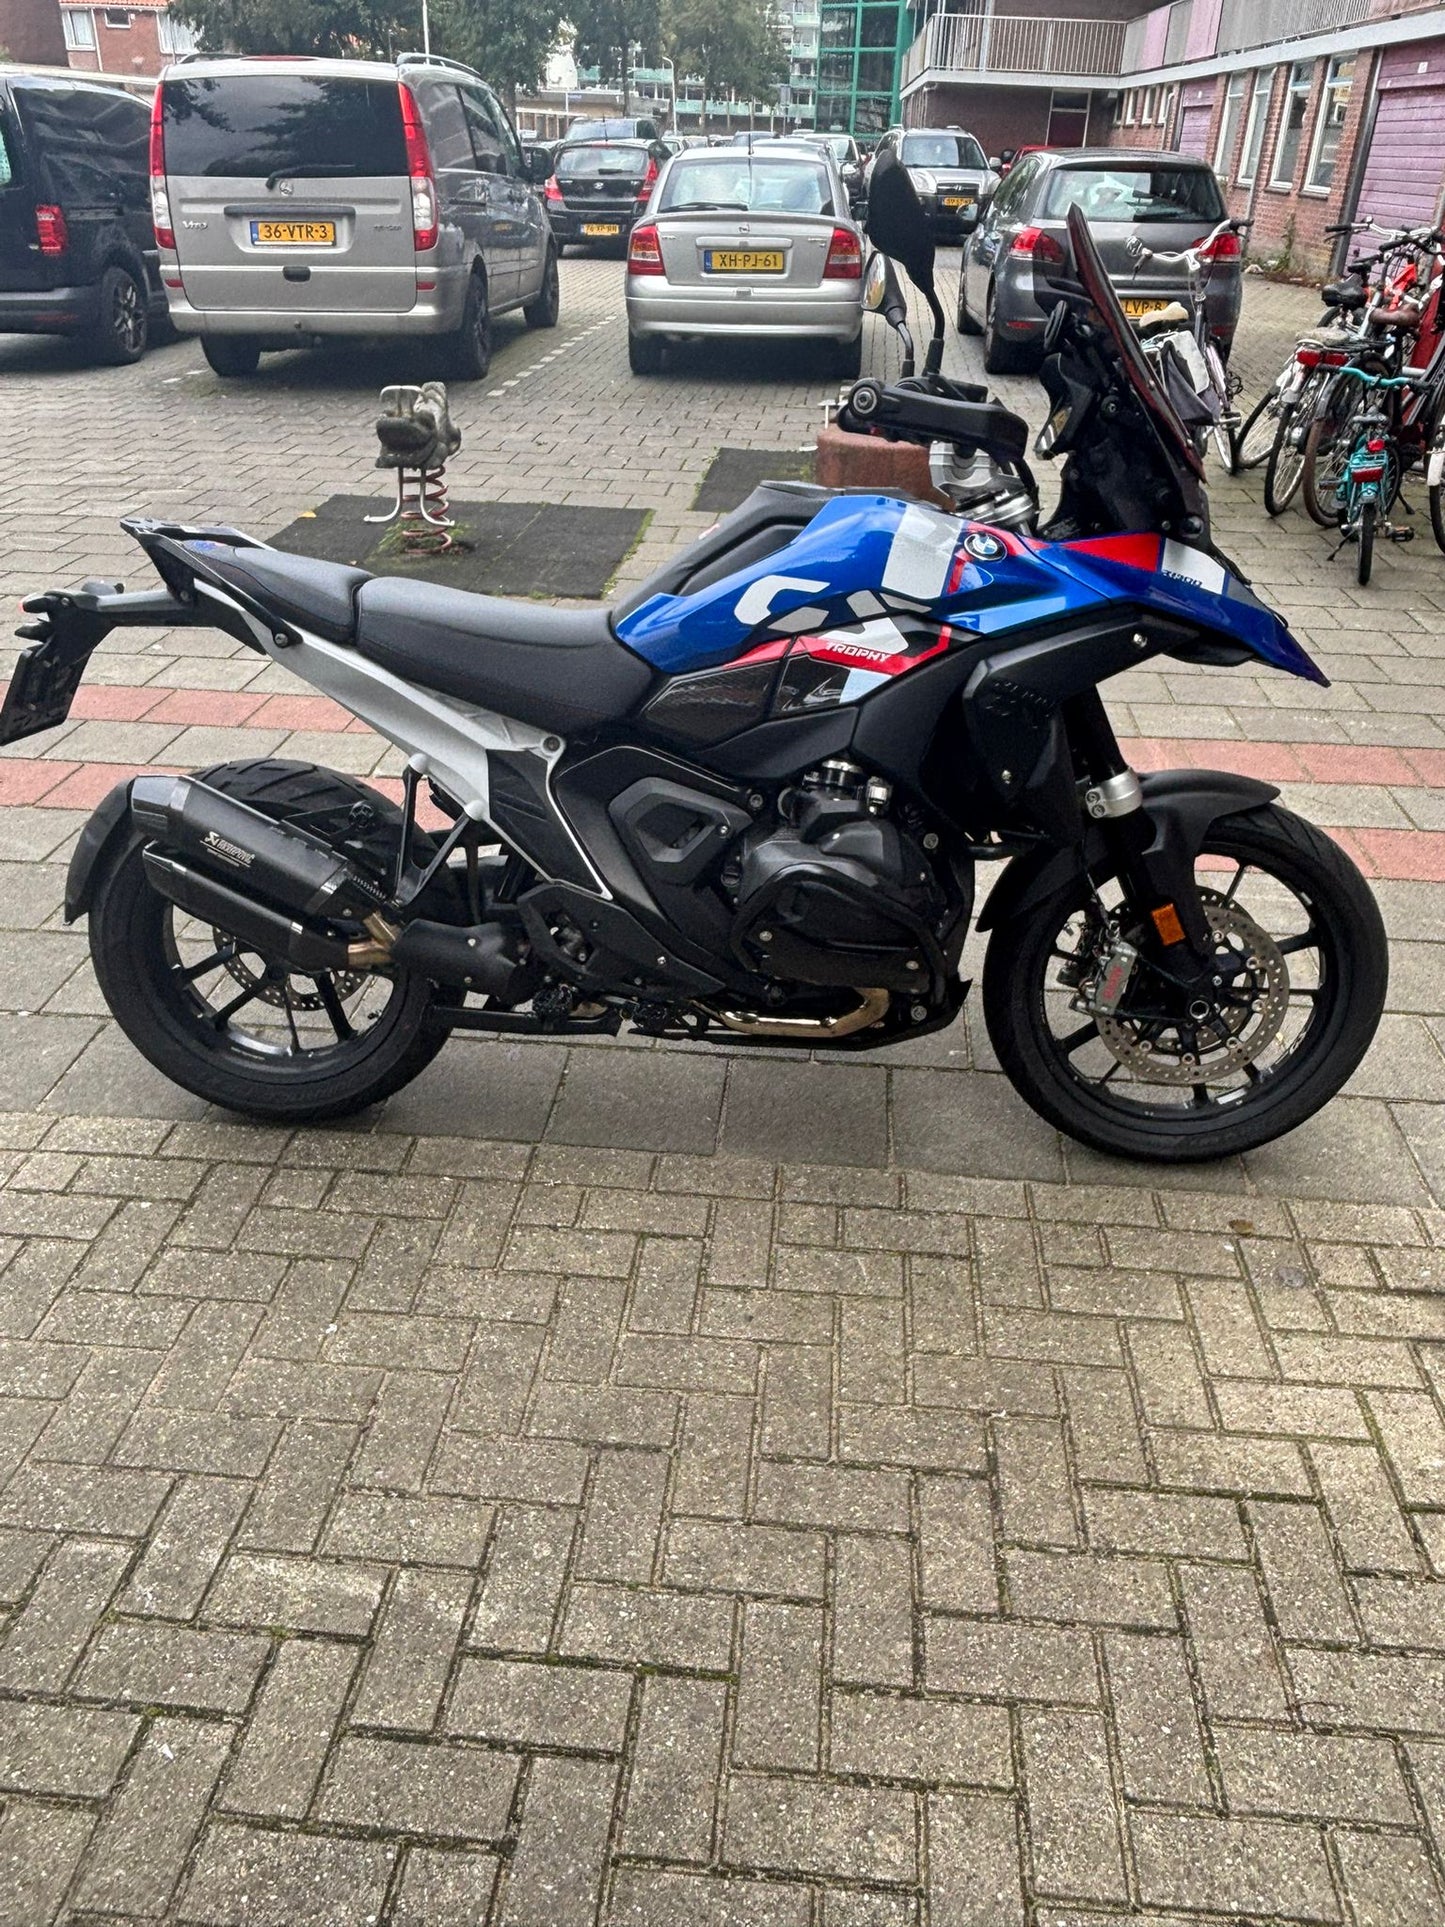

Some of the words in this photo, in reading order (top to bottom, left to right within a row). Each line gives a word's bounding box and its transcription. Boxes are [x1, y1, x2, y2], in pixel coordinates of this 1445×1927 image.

[264, 224, 328, 239] 36-VTR-3
[719, 254, 778, 268] XH-PJ-61
[824, 641, 892, 663] TROPHY
